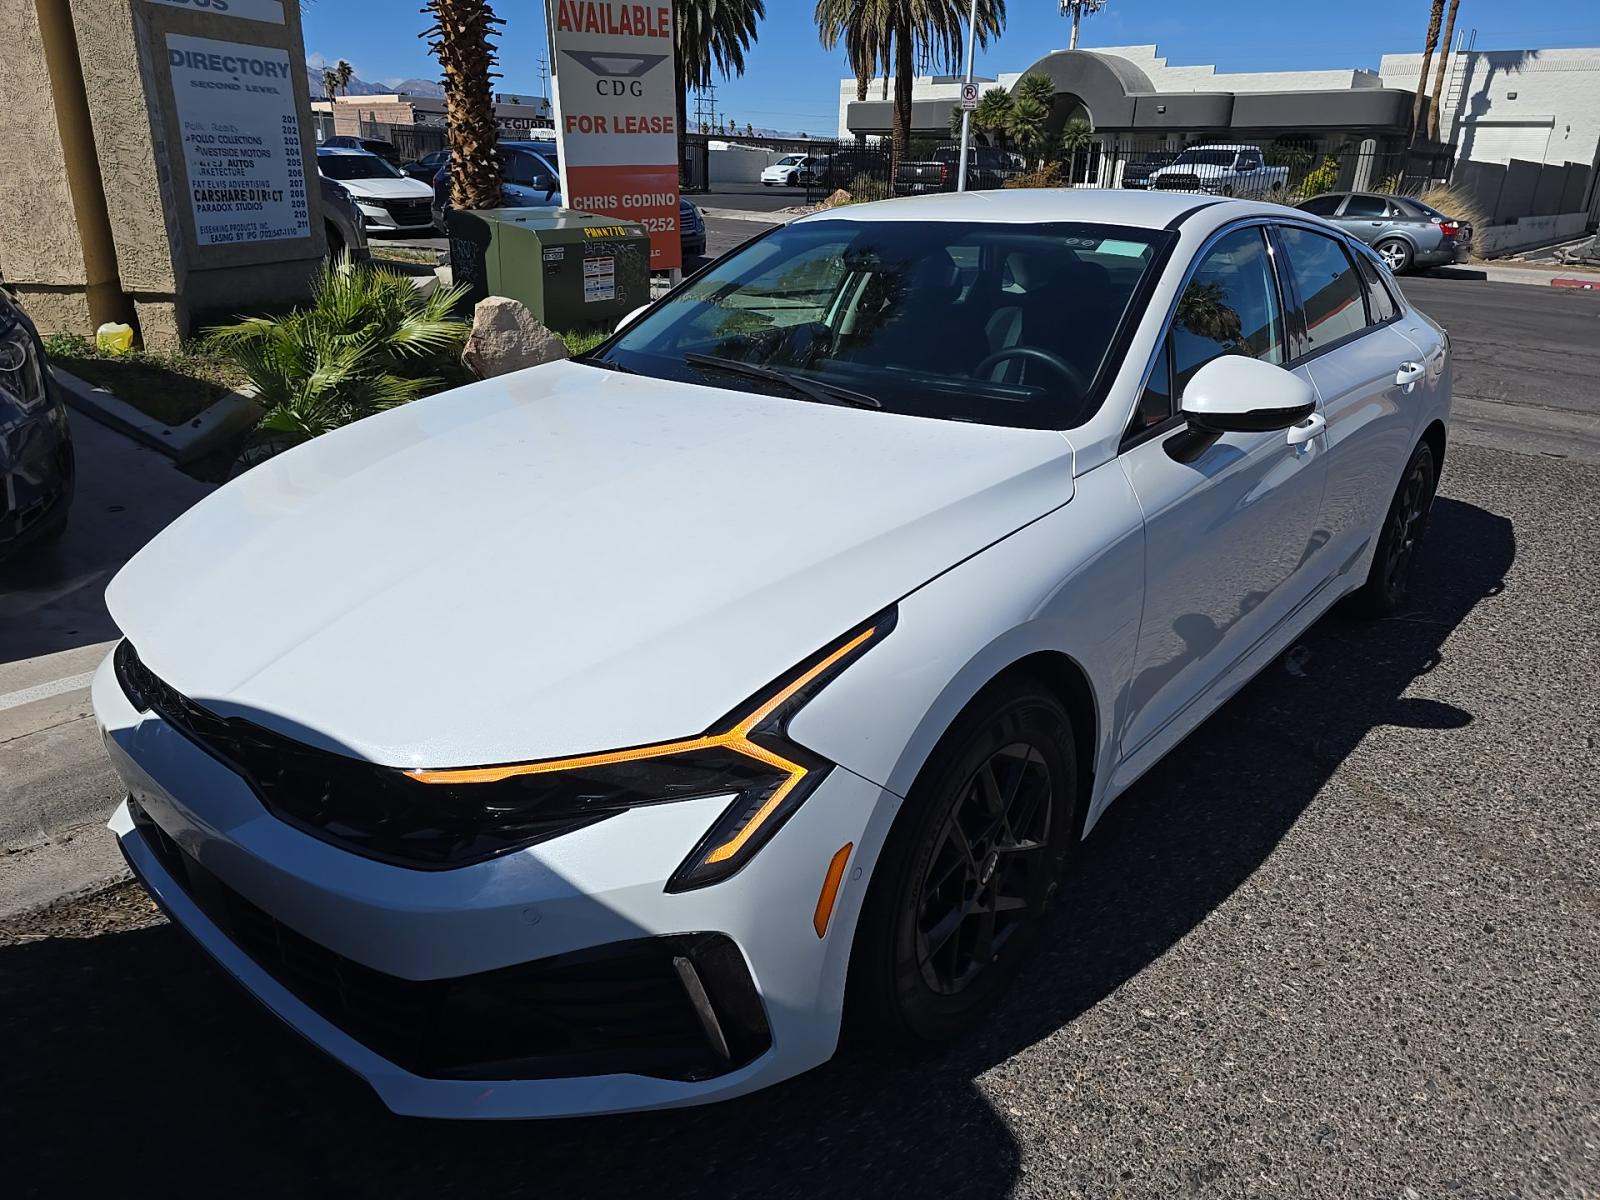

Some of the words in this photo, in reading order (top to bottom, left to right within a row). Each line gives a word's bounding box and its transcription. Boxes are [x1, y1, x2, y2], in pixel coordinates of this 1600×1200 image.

[558, 0, 669, 38] AVAILABLE
[169, 49, 289, 78] DIRECTORY
[190, 80, 241, 91] SECOND
[245, 84, 280, 95] LEVEL
[596, 80, 642, 97] CDG
[281, 115, 296, 124] 201
[565, 115, 608, 134] FOR
[613, 116, 674, 134] LEASE
[282, 125, 297, 135] 202
[217, 135, 263, 146] COLLECTIONS
[284, 136, 299, 145] 203
[240, 149, 272, 158] MOTORS
[285, 147, 300, 156] 204
[228, 159, 255, 168] AUTOS
[286, 158, 302, 167] 205
[288, 168, 303, 177] 206
[228, 180, 271, 188] ADVERTISING
[289, 179, 303, 187] 207
[194, 189, 247, 203] CARSHARE
[290, 189, 305, 198] 208
[291, 199, 306, 208] 209
[573, 195, 618, 210] CHRIS
[622, 192, 676, 208] GODINO
[197, 203, 233, 213] PARADOX
[235, 202, 263, 212] STUDIOS
[294, 210, 307, 218] 210
[297, 220, 308, 228] 211
